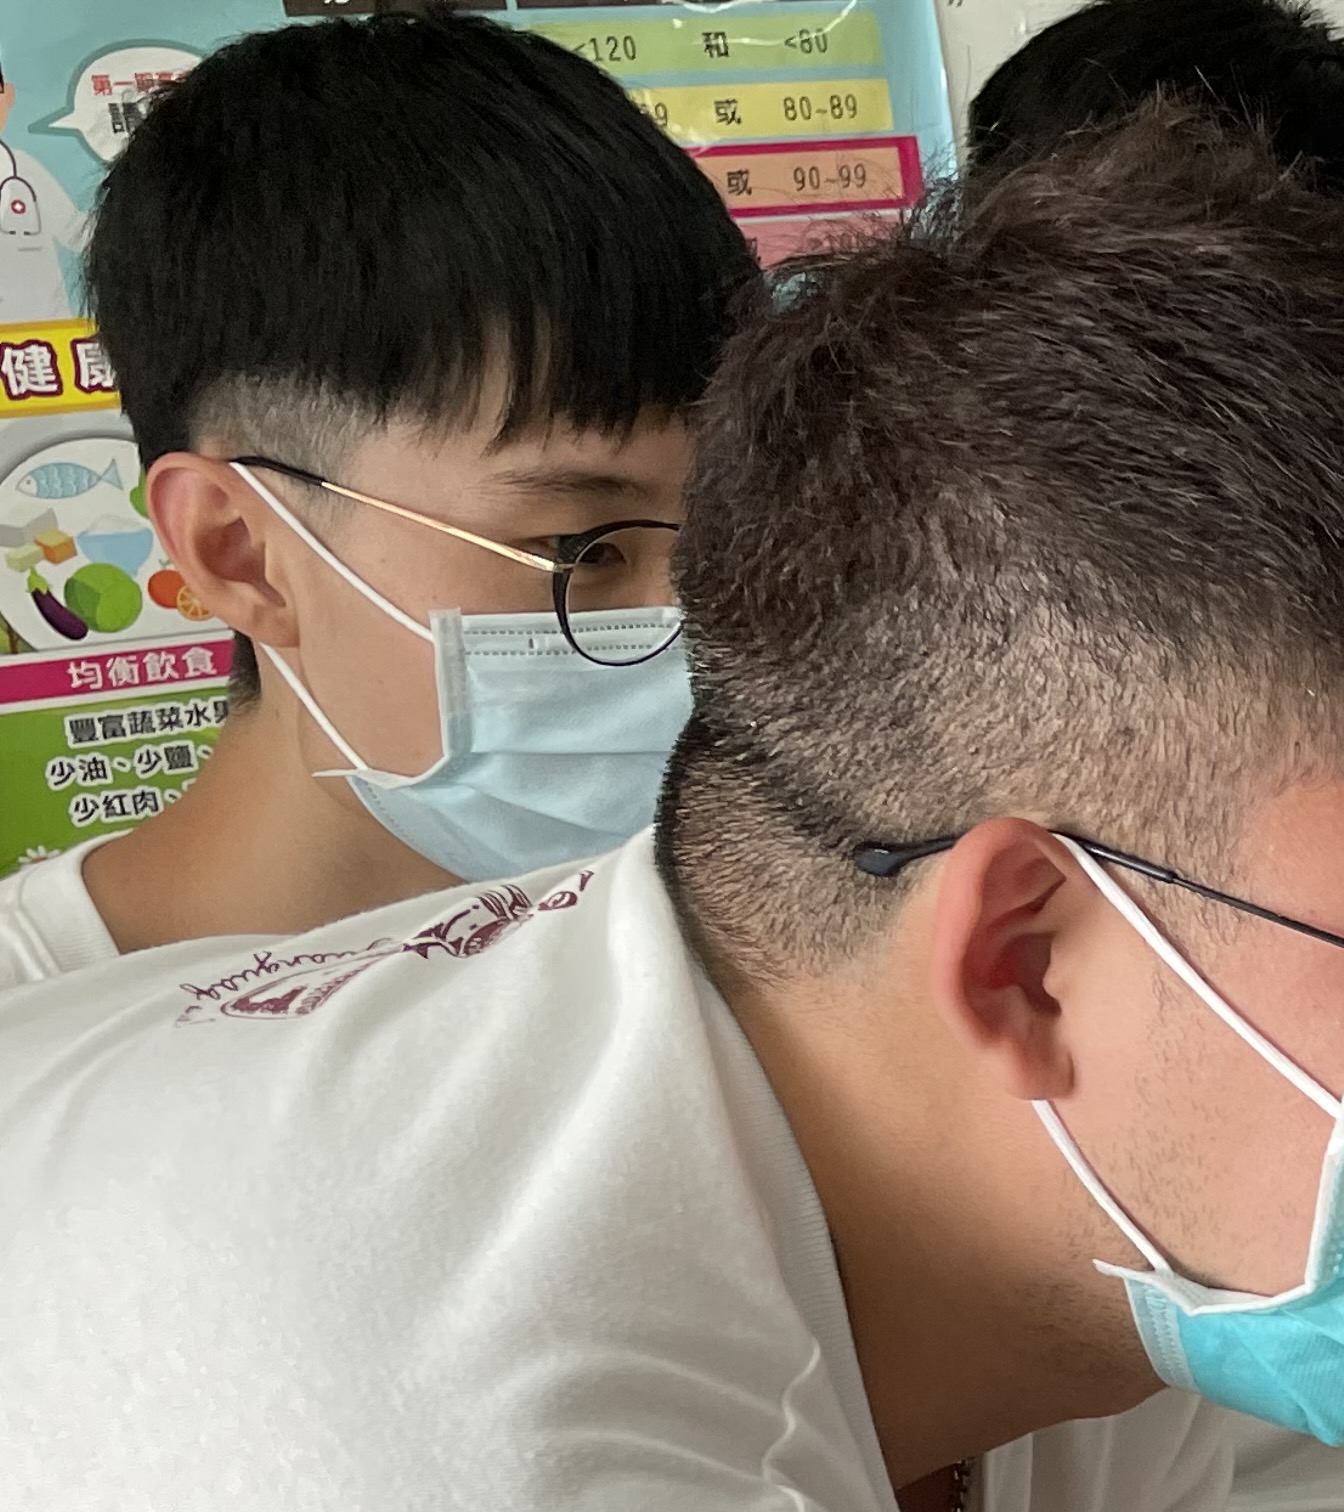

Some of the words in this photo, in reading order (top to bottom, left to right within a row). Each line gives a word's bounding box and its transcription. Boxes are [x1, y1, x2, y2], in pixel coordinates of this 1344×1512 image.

[702, 31, 731, 59] 和
[715, 98, 743, 126] 或
[726, 169, 755, 198] 或
[66, 646, 218, 691] 均衡飲食
